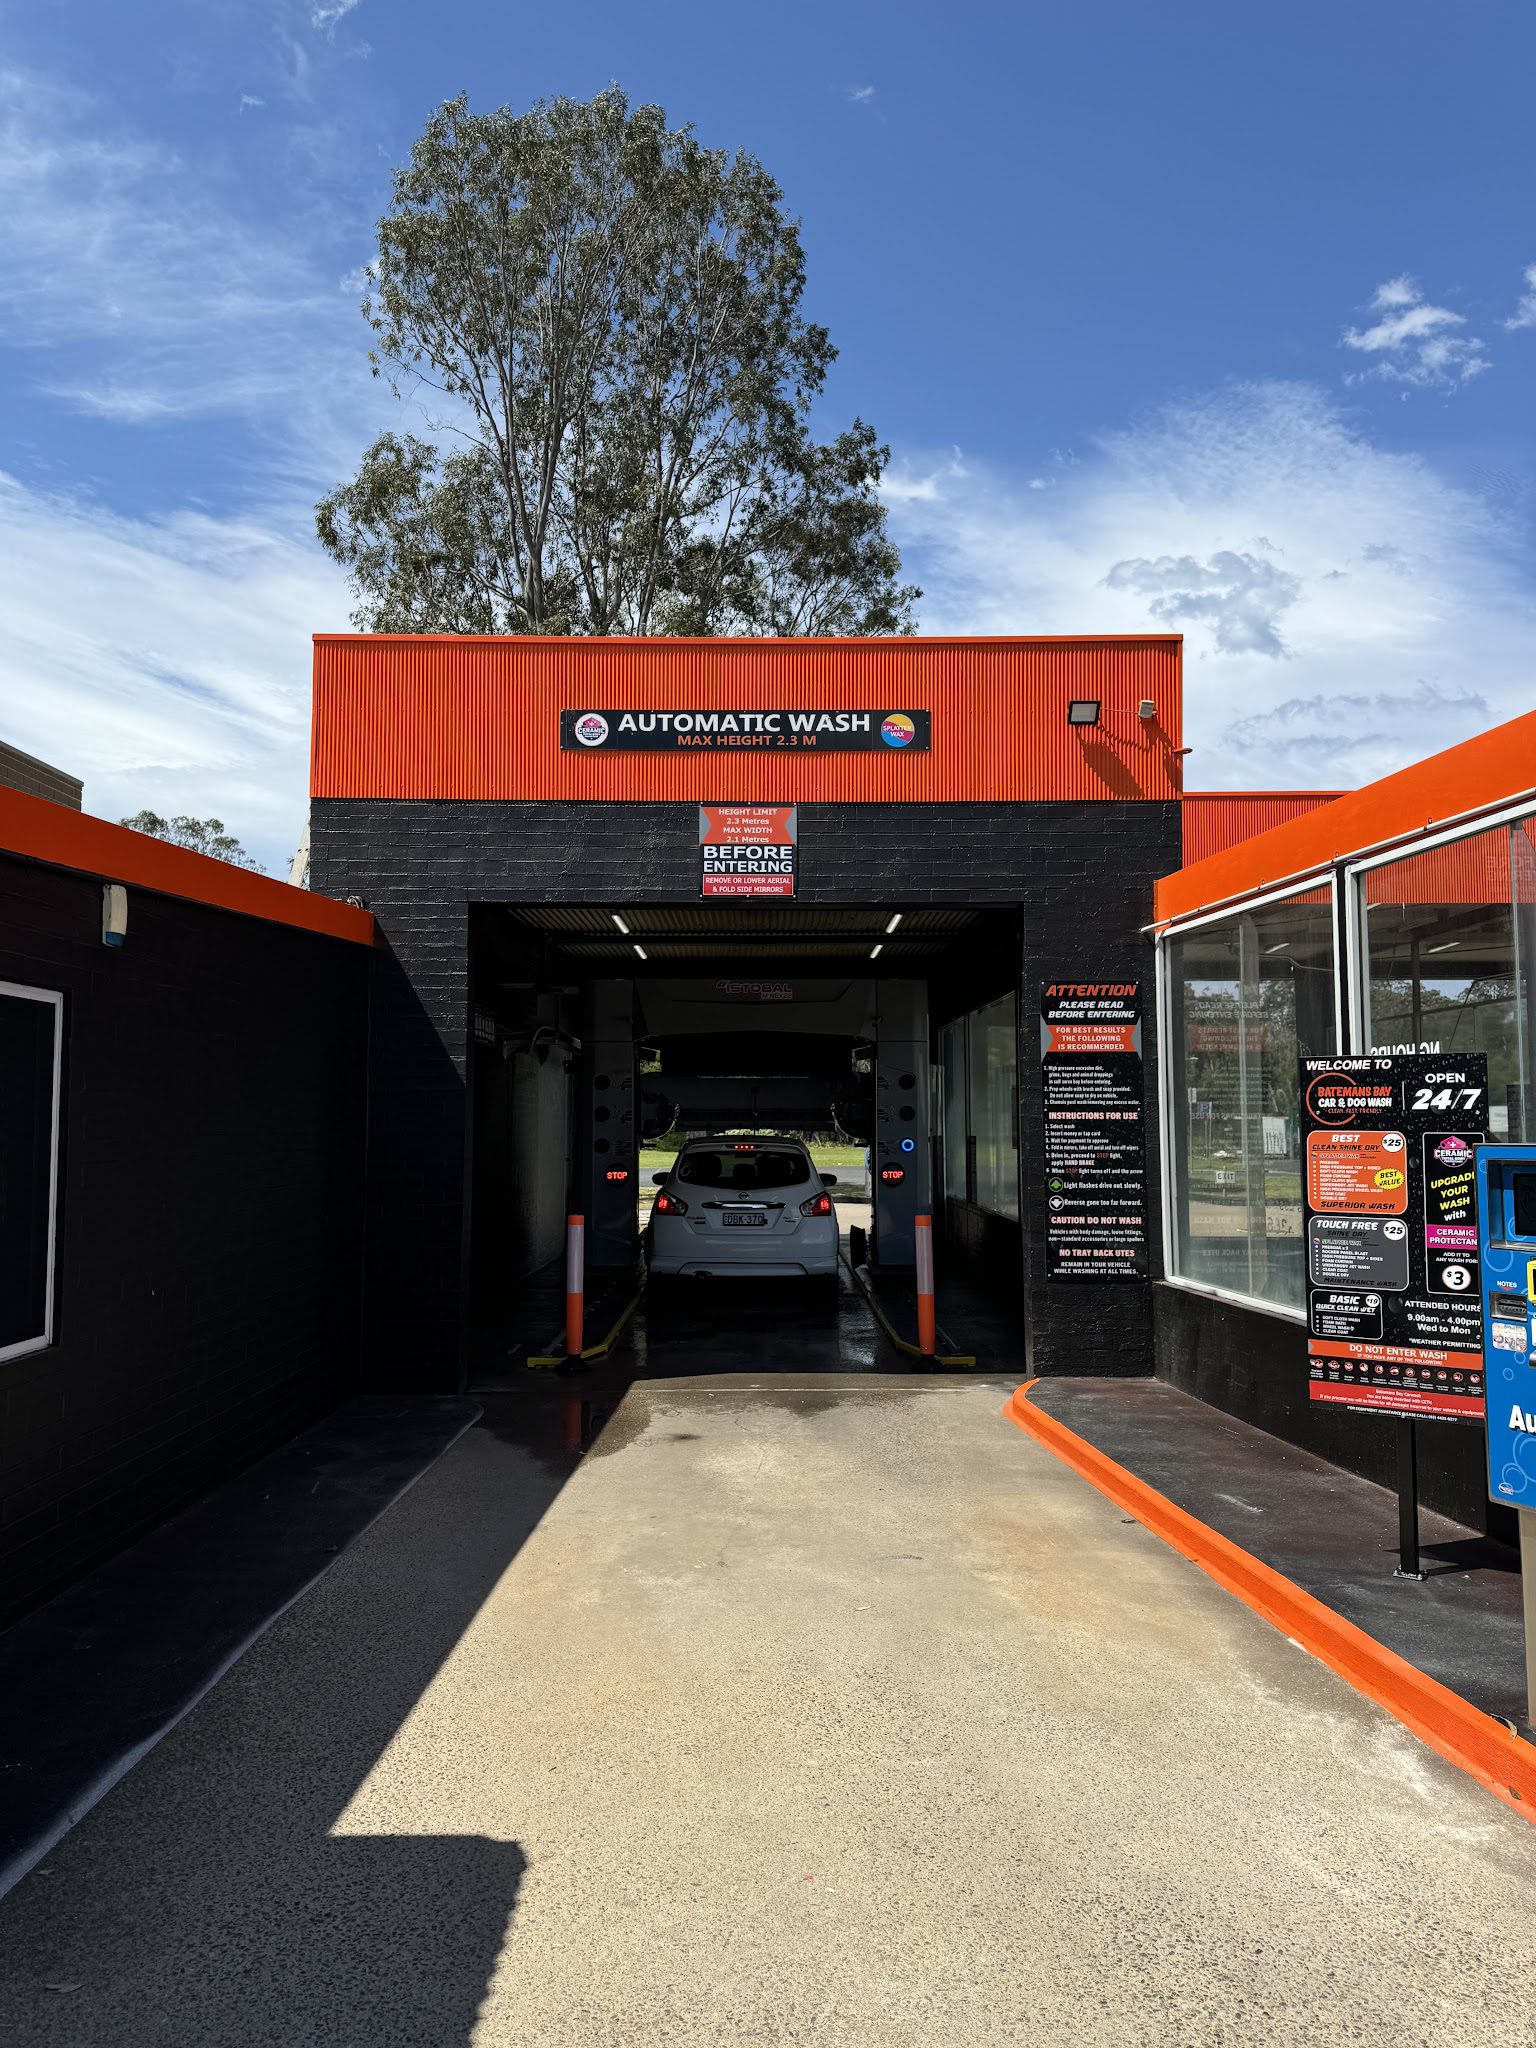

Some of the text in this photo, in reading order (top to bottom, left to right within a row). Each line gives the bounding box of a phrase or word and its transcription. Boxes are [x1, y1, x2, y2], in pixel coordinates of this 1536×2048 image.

[618, 714, 870, 732] AUTOMATIC WASH
[678, 735, 816, 745] MAX HEIGHT 2.3 M
[704, 846, 792, 859] BEFORE
[704, 861, 792, 872] ENTERING
[726, 982, 792, 993] ISTOBAL
[1046, 985, 1136, 996] ATTENTION
[1306, 1059, 1392, 1070] WELCOME TO
[1425, 1073, 1466, 1083] OPEN
[1318, 1086, 1392, 1097] BATEMANS BAY
[1318, 1098, 1392, 1107] CAR & DOG WASH
[1412, 1088, 1481, 1110] 24/7
[1431, 1171, 1475, 1188] UPGRAD
[1441, 1185, 1468, 1198] YOUR
[1440, 1197, 1470, 1210] WASH
[1444, 1210, 1466, 1221] with
[1316, 1220, 1378, 1230] TOUCH FREE
[1447, 1271, 1464, 1285] $3
[1330, 1295, 1360, 1304] BASIC
[1404, 1300, 1480, 1312] ATTENDED HOURS
[1407, 1313, 1439, 1323] 9.00am
[1447, 1316, 1480, 1326] 4.00pm
[1417, 1323, 1437, 1331] Wed
[1451, 1326, 1470, 1334] Mon
[1443, 1341, 1481, 1349] PERMITTING
[1387, 1348, 1416, 1357] ENTER
[1420, 1350, 1447, 1360] WASH
